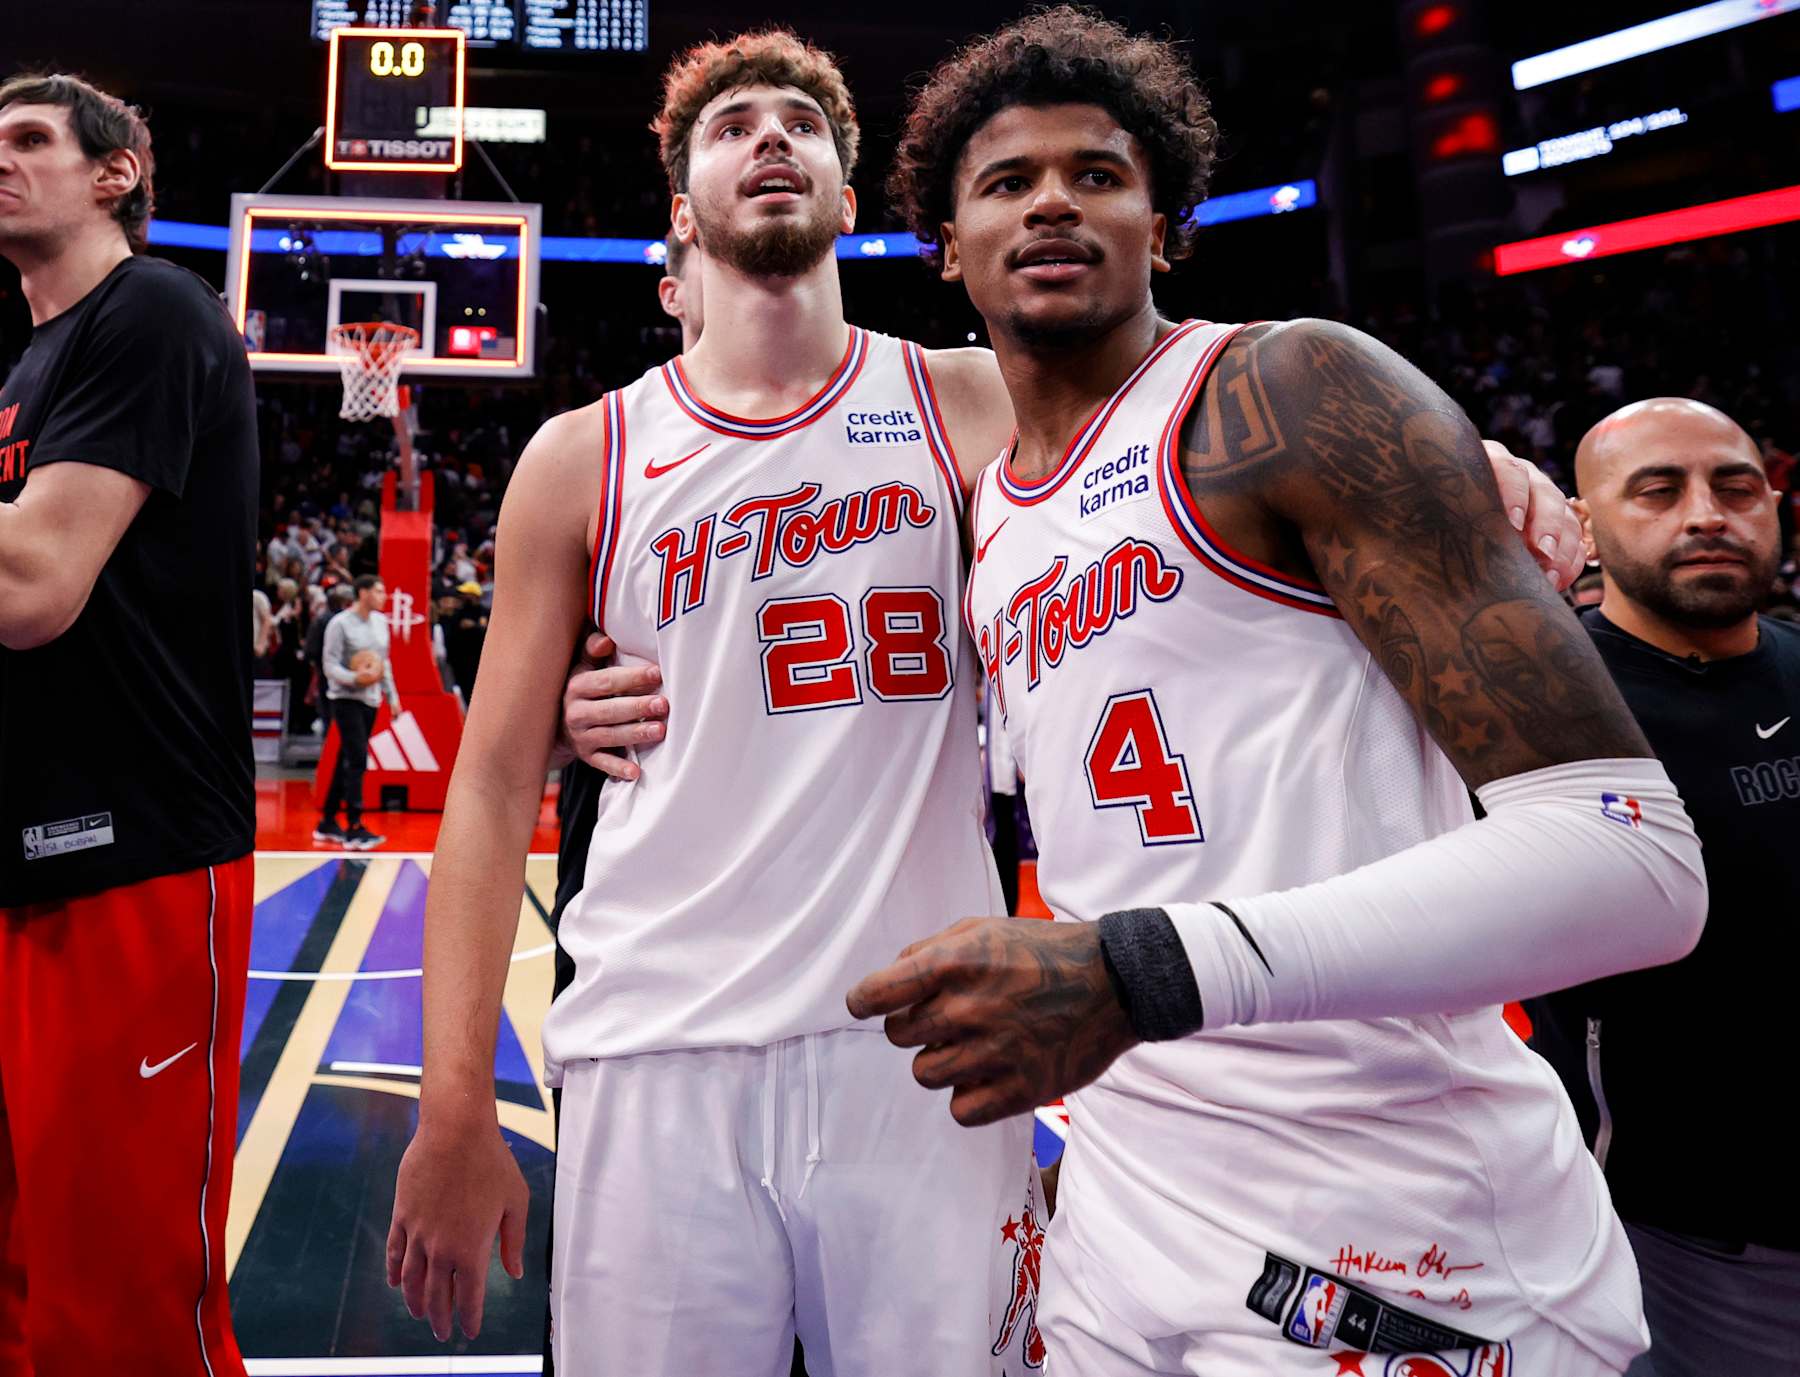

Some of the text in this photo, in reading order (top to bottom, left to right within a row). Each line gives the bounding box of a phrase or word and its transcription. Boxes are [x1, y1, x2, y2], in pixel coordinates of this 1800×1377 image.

[370, 41, 425, 77] 0.0
[367, 140, 452, 159] TISSOT
[846, 426, 922, 444] karma
[847, 410, 916, 426] credit
[1083, 443, 1150, 490] credit
[1080, 474, 1150, 519] karma
[651, 480, 936, 632] H-Town
[756, 585, 954, 716] 28
[979, 536, 1184, 728] H-Town
[1084, 687, 1205, 848] 4
[1347, 1313, 1368, 1332] 44
